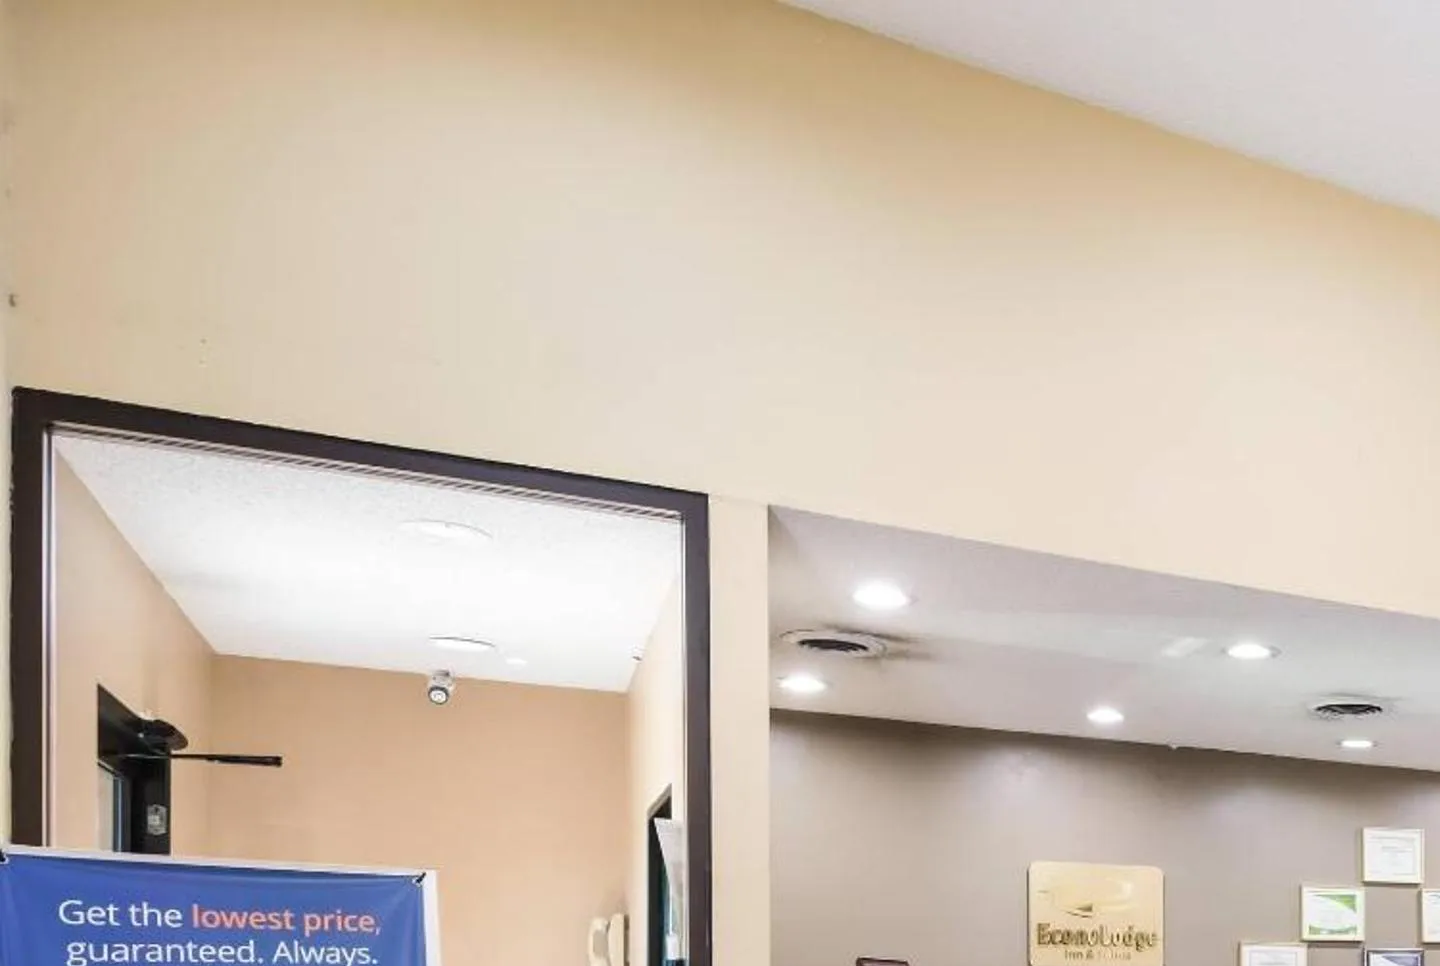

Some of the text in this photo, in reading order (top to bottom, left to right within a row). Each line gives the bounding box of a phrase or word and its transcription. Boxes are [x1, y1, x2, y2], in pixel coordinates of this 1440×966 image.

[59, 900, 381, 937] Get the lowest price,
